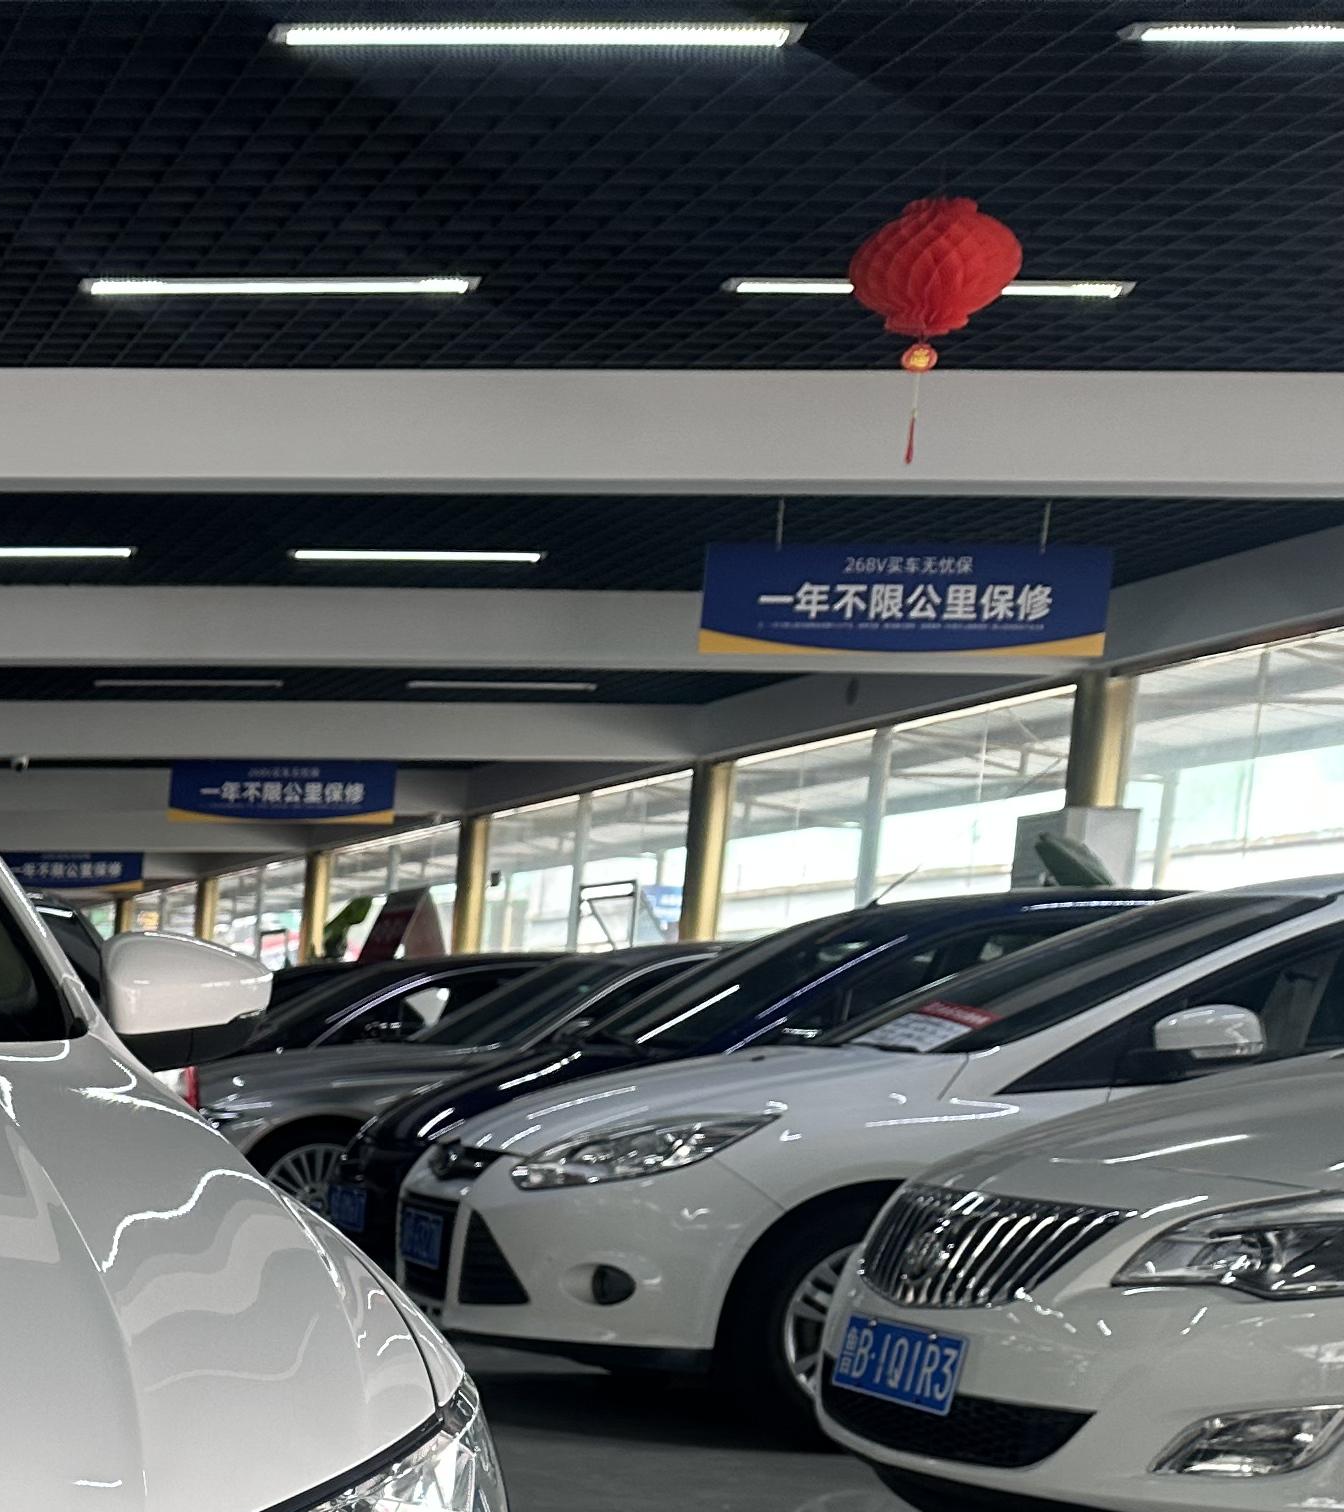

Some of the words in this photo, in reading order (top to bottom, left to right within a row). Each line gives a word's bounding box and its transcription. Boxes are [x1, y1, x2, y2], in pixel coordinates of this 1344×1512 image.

[758, 582, 1053, 621] 一年不限公里保修
